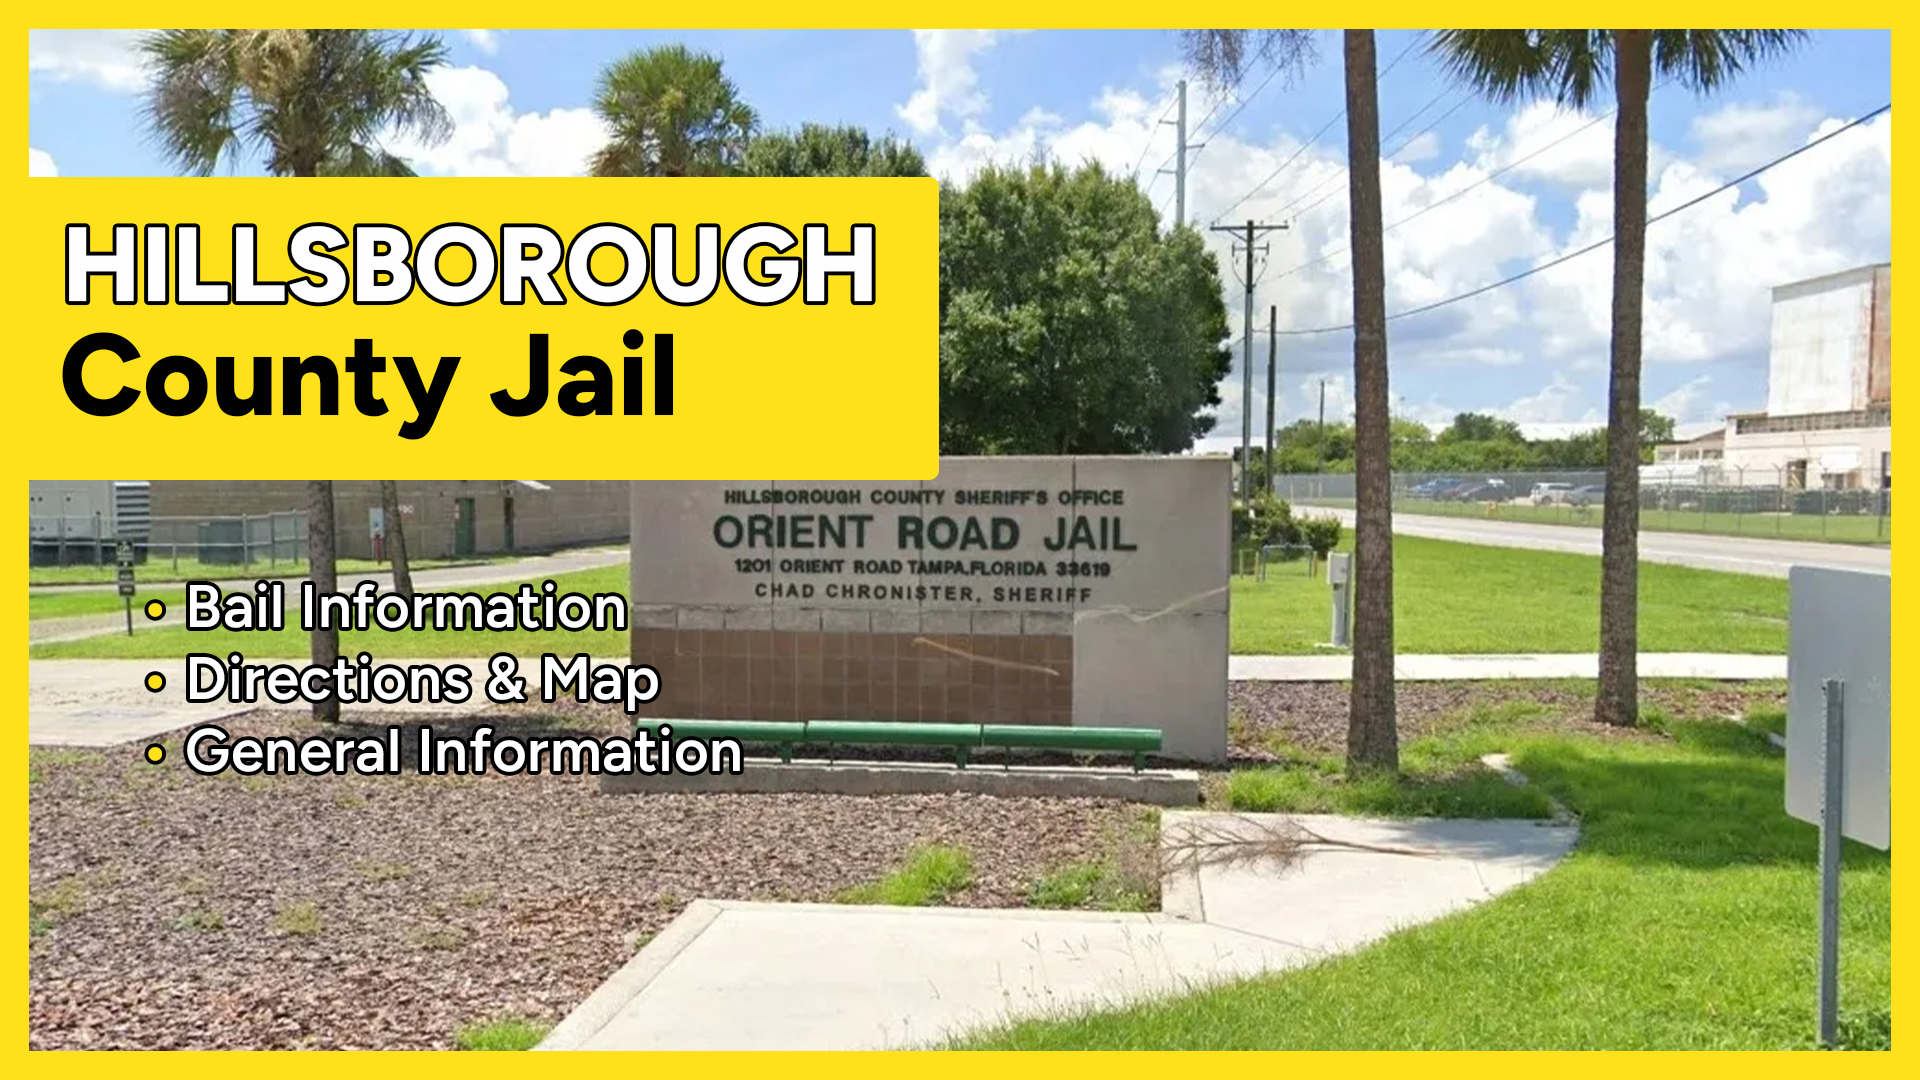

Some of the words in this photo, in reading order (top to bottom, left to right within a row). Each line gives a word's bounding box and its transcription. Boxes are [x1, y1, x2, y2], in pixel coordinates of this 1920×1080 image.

[724, 489, 861, 505] HILLSBOROUGH
[871, 490, 946, 506] COUNTY
[954, 490, 1049, 506] SHERIFF'S
[1058, 490, 1124, 506] OFFICE
[713, 513, 874, 549] ORIENT
[897, 515, 1021, 551] ROAD
[1044, 515, 1138, 552] JAIL
[734, 558, 772, 574] 1201
[779, 558, 846, 575] ORIENT
[853, 559, 904, 576] ROAD
[1056, 561, 1111, 578] 33619
[754, 582, 815, 599] CHAD
[826, 584, 982, 604] CHRONISTER,
[993, 586, 1093, 603] SHERIFF
